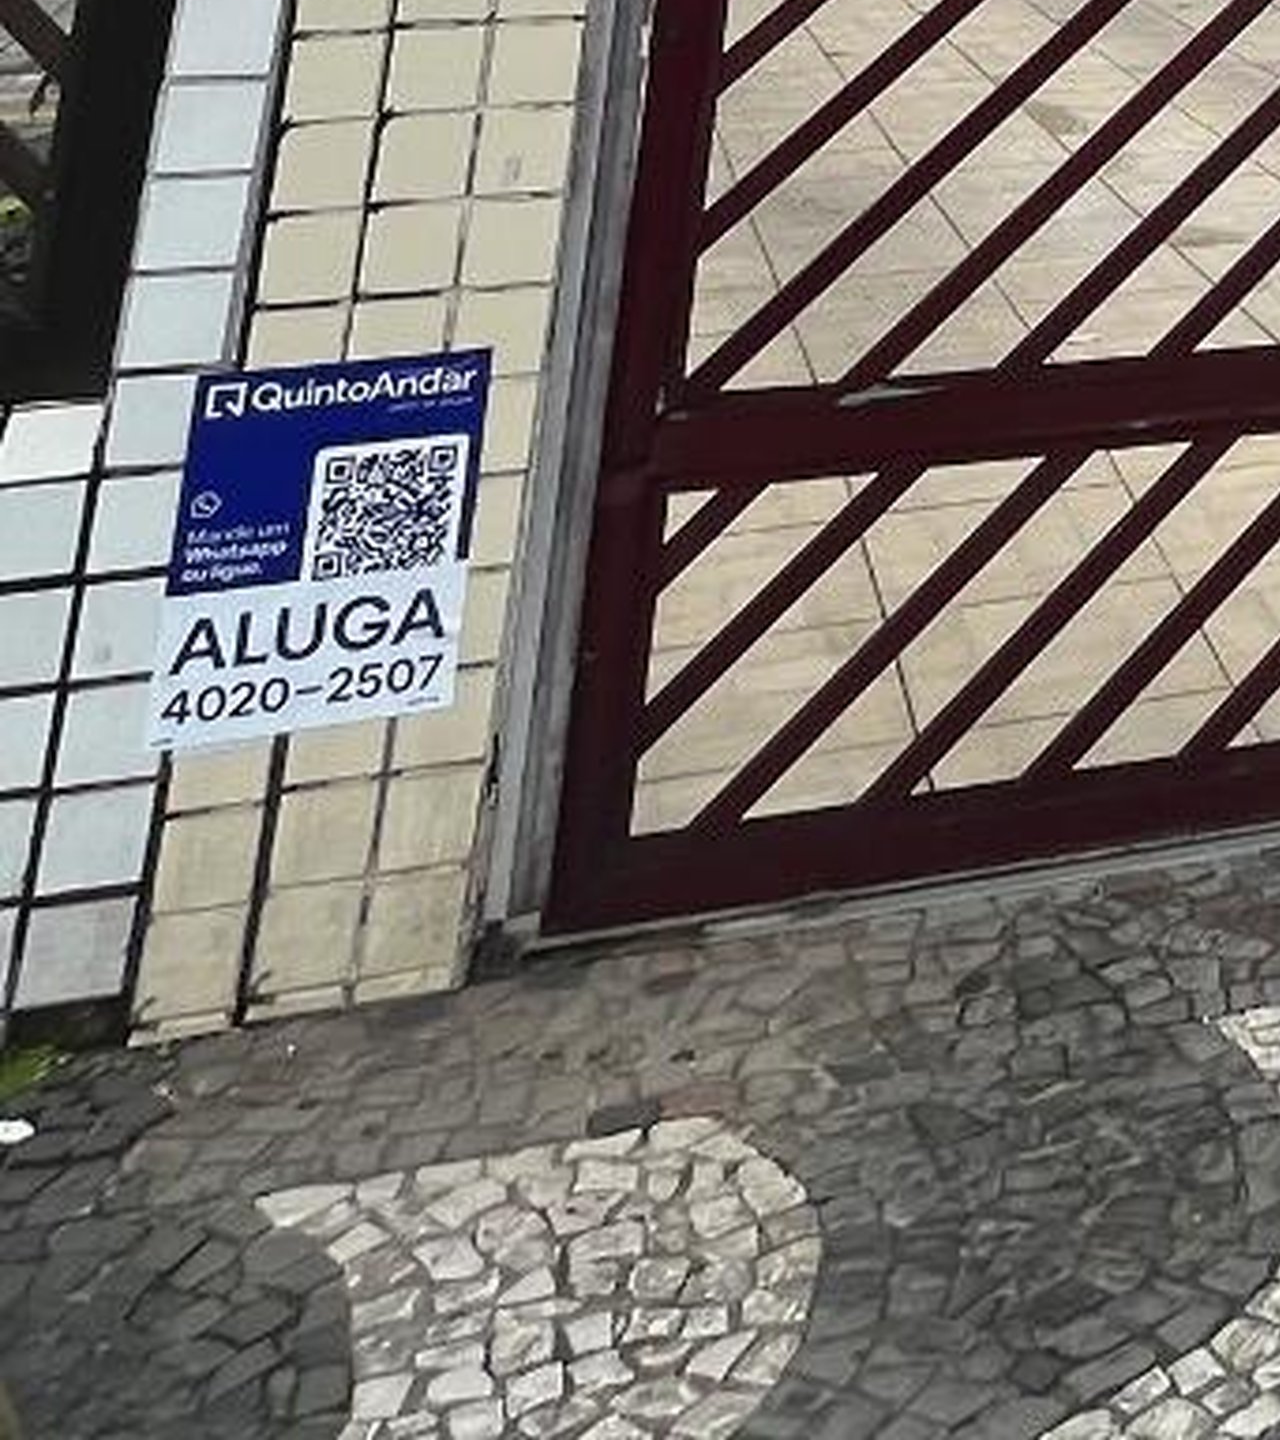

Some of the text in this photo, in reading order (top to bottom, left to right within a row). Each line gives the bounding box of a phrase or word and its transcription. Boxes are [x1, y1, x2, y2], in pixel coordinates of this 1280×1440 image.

[250, 367, 477, 414] QuintoAndar
[168, 587, 446, 677] ALUGA
[161, 653, 444, 726] 4020-2507
